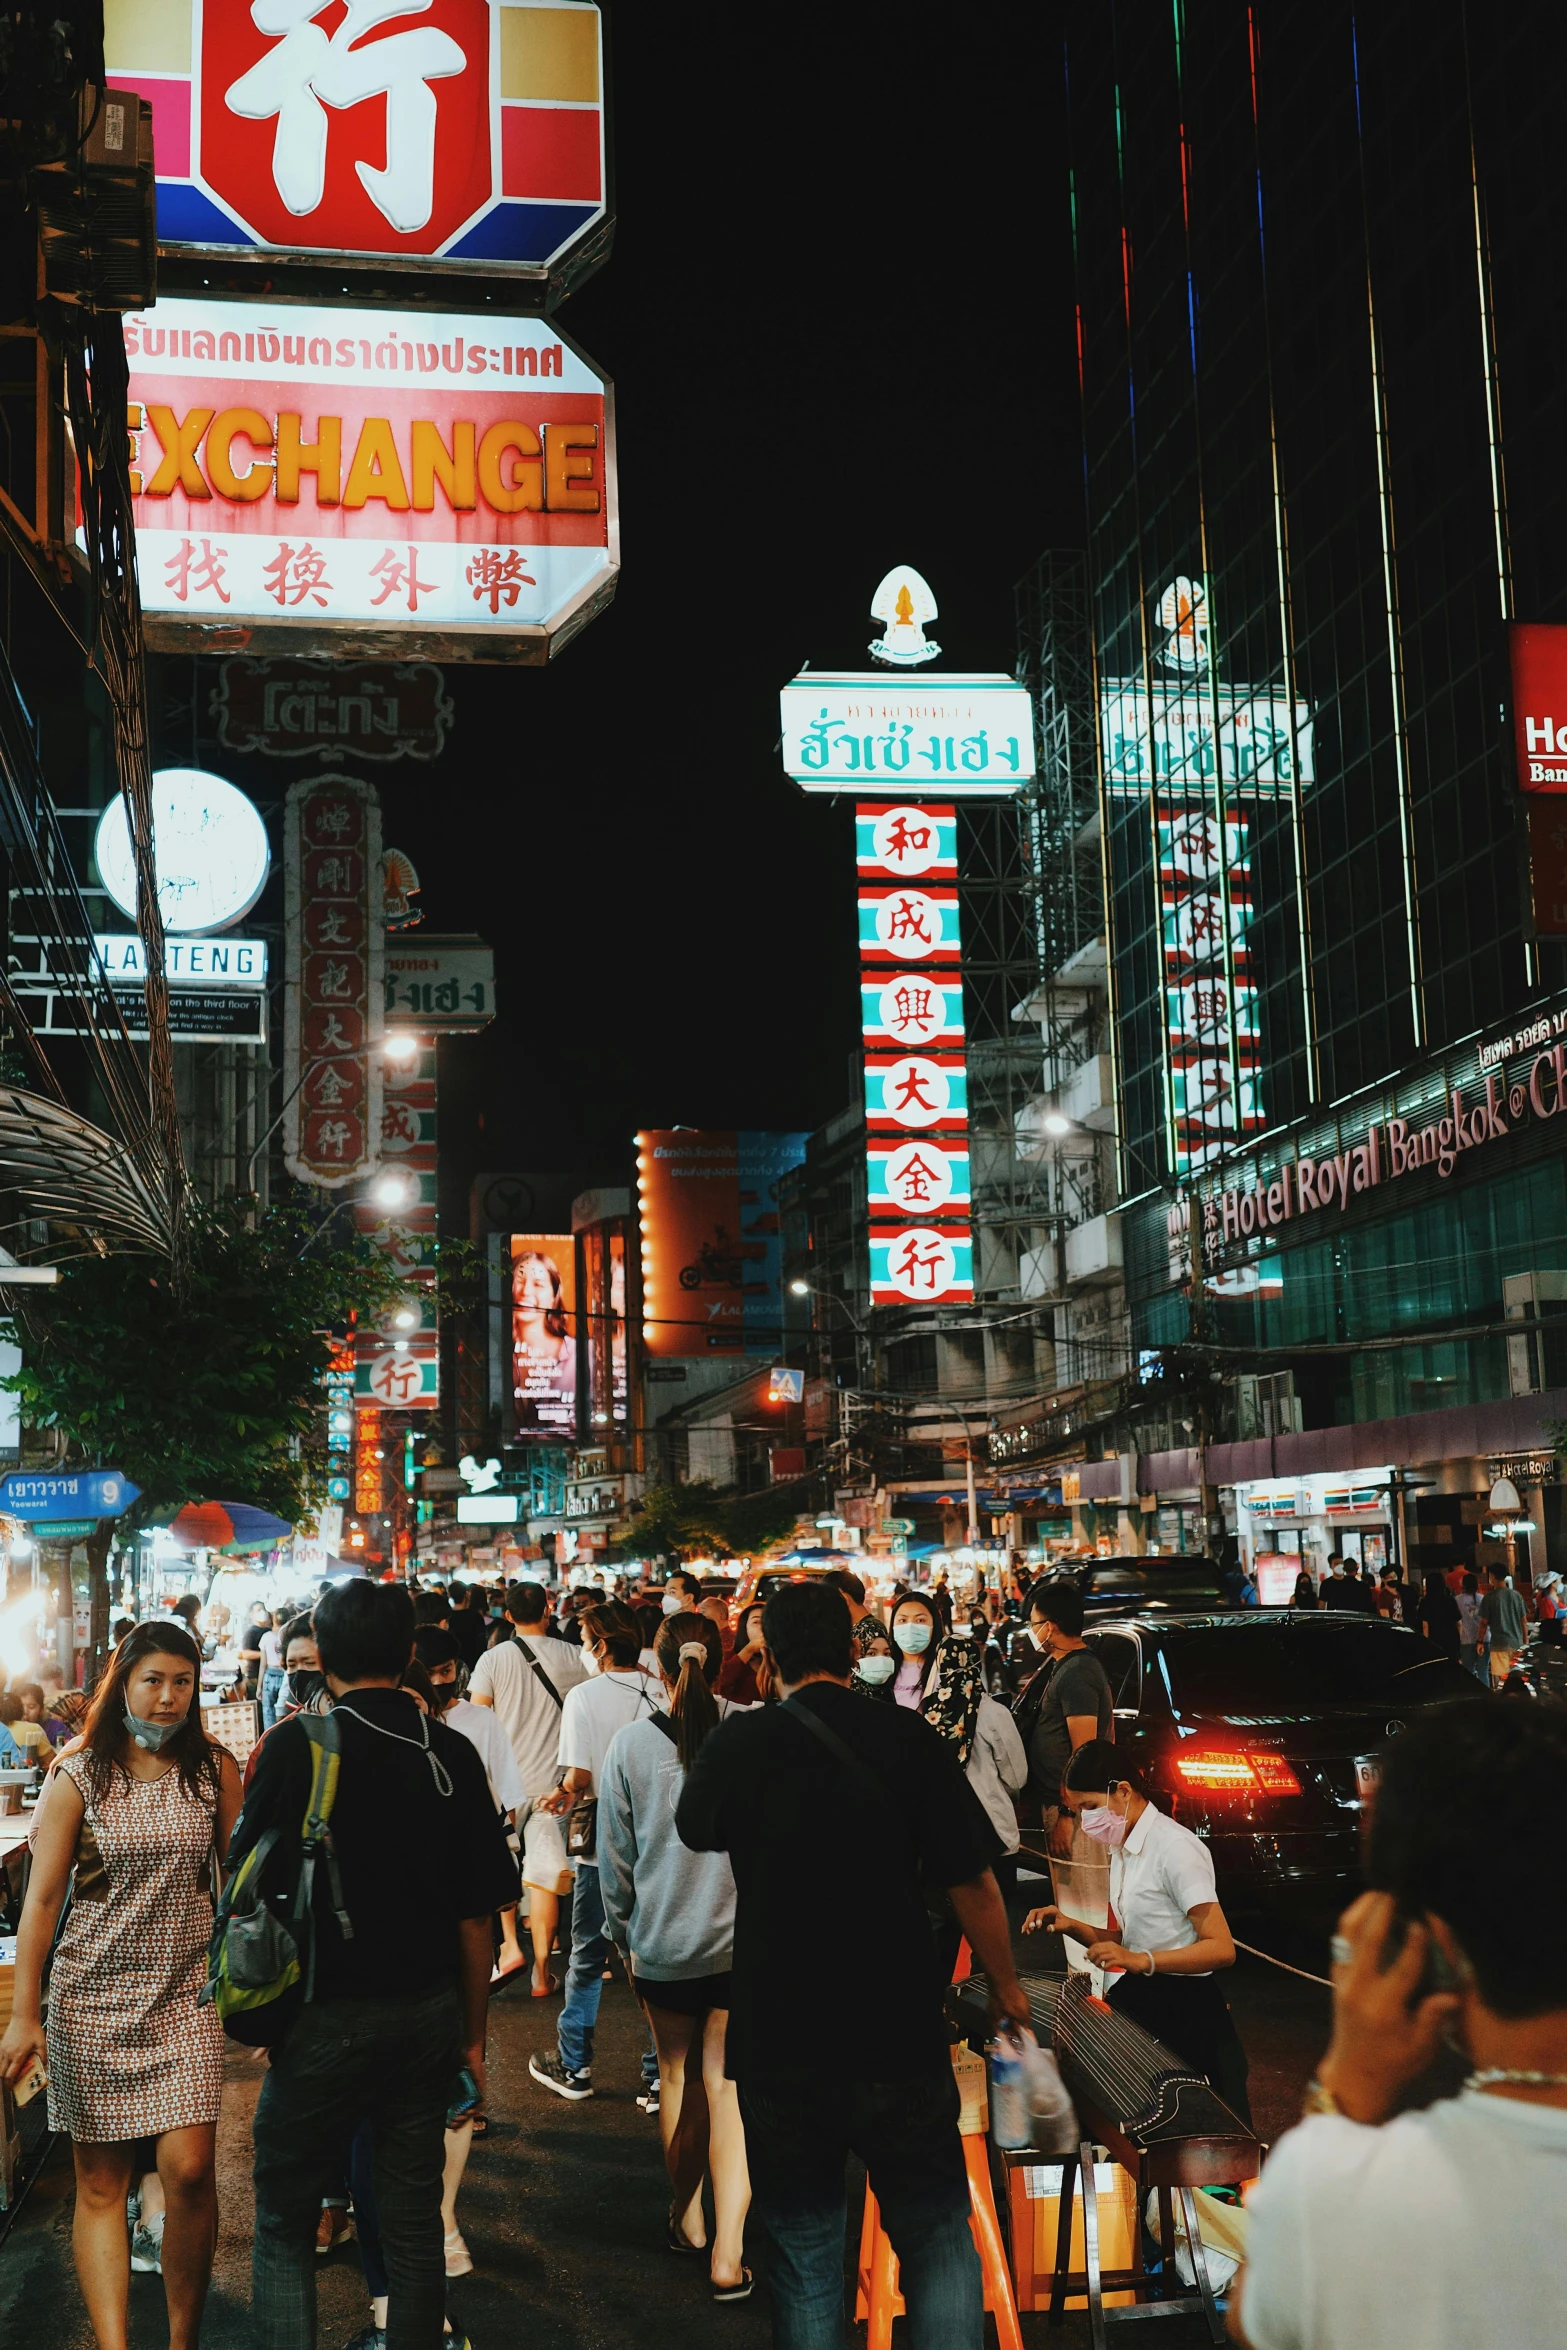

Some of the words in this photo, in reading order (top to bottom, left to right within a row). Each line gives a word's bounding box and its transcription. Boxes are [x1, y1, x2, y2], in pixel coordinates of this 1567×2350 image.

[225, 0, 467, 233] 行
[124, 317, 563, 378] รับแลกเงินตราต่างประเทศ
[127, 402, 601, 514] XCHANGE
[164, 538, 537, 614] 找換外幣
[104, 943, 253, 973] LATENG
[169, 998, 182, 1007] on
[185, 998, 200, 1008] the
[203, 998, 225, 1008] third
[228, 1000, 250, 1010] floor
[885, 816, 945, 1288] 和成興大金行
[1221, 1165, 1292, 1243] Hotel
[1297, 1126, 1381, 1211] Royal
[8, 1478, 79, 1498] เยาวราช
[102, 1479, 119, 1504] 9
[10, 1499, 48, 1508] Yaowarat
